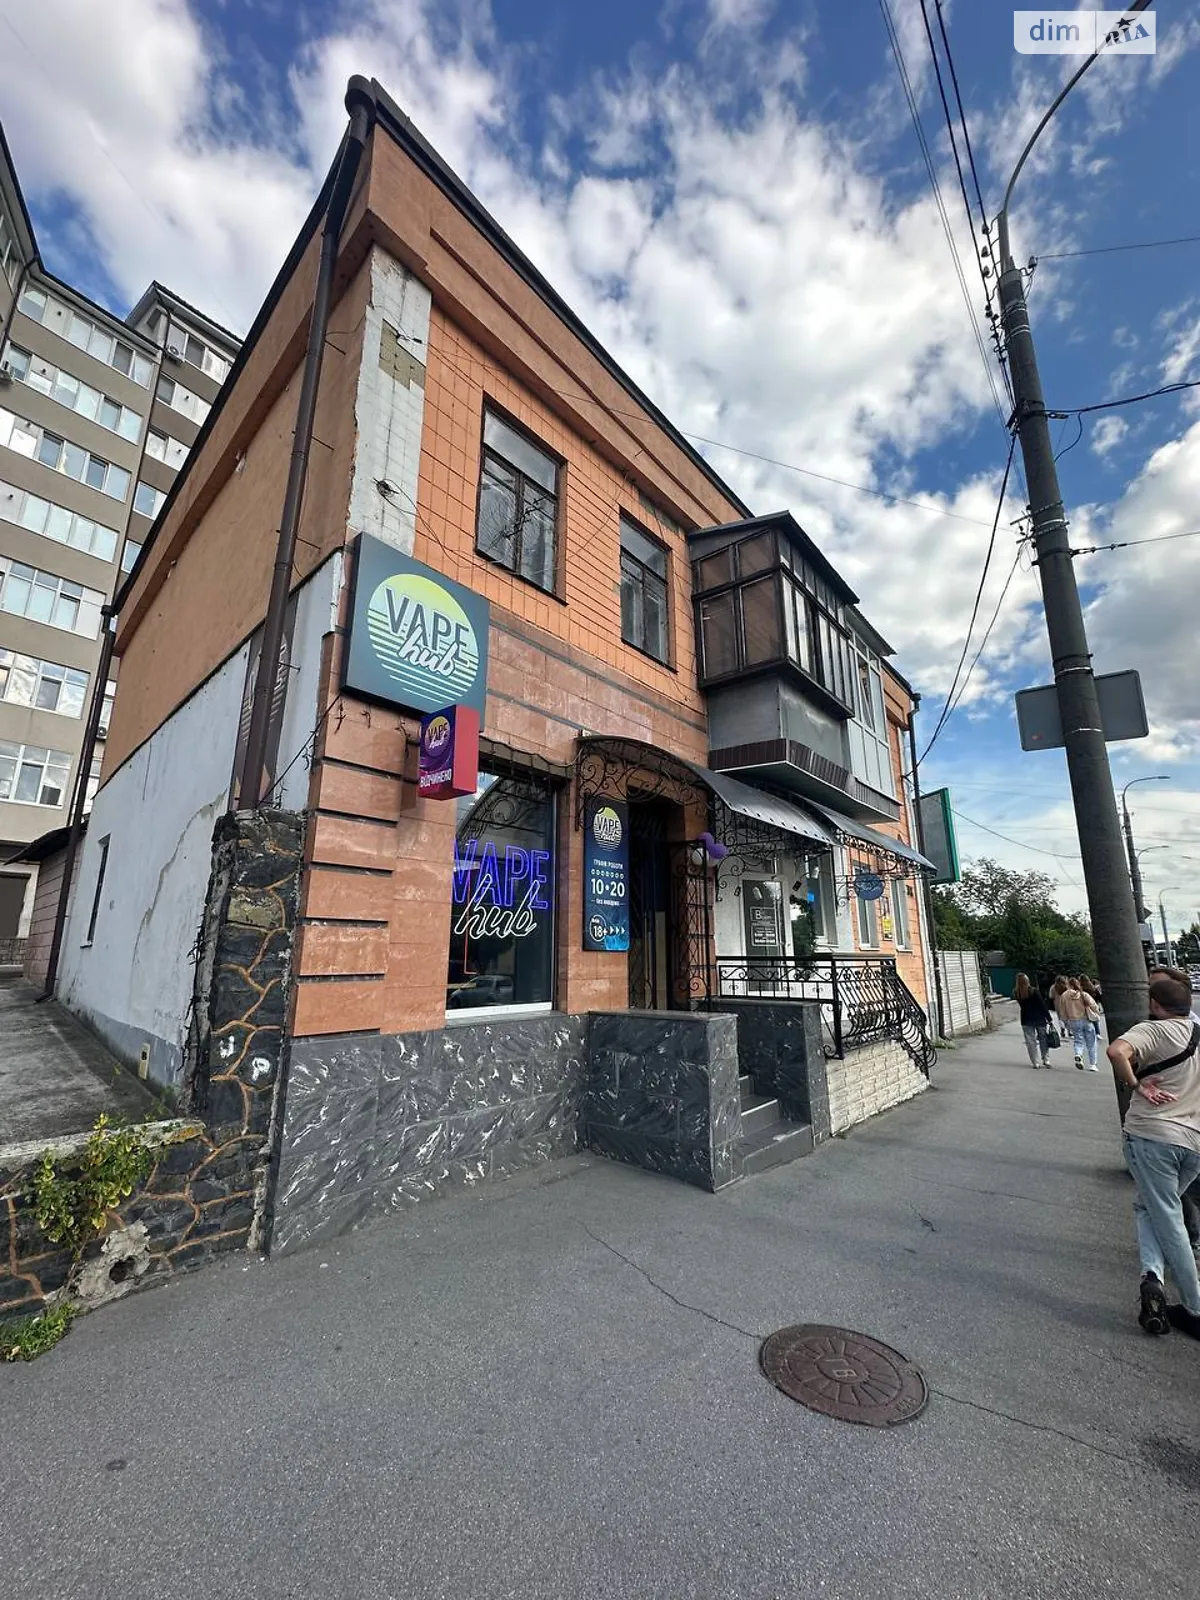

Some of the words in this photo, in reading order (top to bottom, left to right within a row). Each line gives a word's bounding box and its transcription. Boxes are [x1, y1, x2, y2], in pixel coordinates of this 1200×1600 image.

[385, 587, 470, 666] VAPE
[398, 623, 455, 676] hub
[428, 722, 449, 743] VAPE
[453, 838, 550, 910] VAPE
[454, 873, 540, 940] hub
[593, 924, 608, 938] 18+
